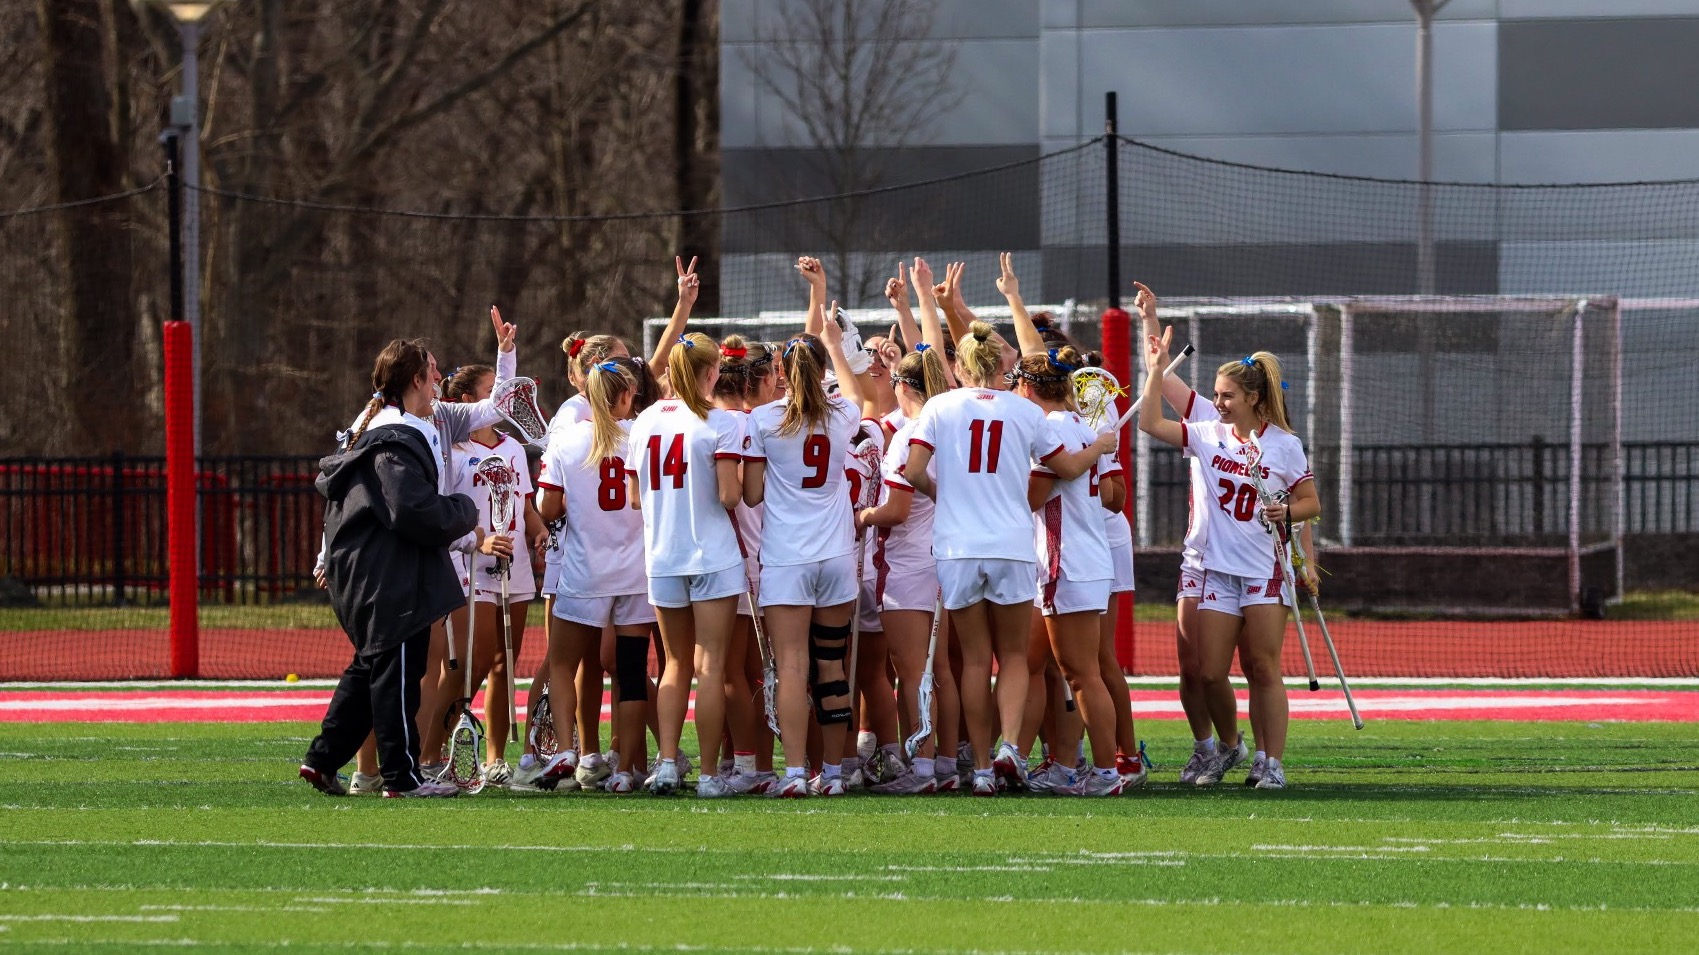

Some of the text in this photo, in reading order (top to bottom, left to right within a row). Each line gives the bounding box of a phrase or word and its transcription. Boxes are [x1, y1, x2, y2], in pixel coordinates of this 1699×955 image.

[660, 405, 678, 413] SHU
[646, 432, 689, 491] 14
[801, 433, 831, 489] 9
[968, 418, 1004, 475] 11
[1211, 454, 1271, 480] PIONES
[597, 455, 627, 512] 8
[1218, 477, 1258, 522] 20
